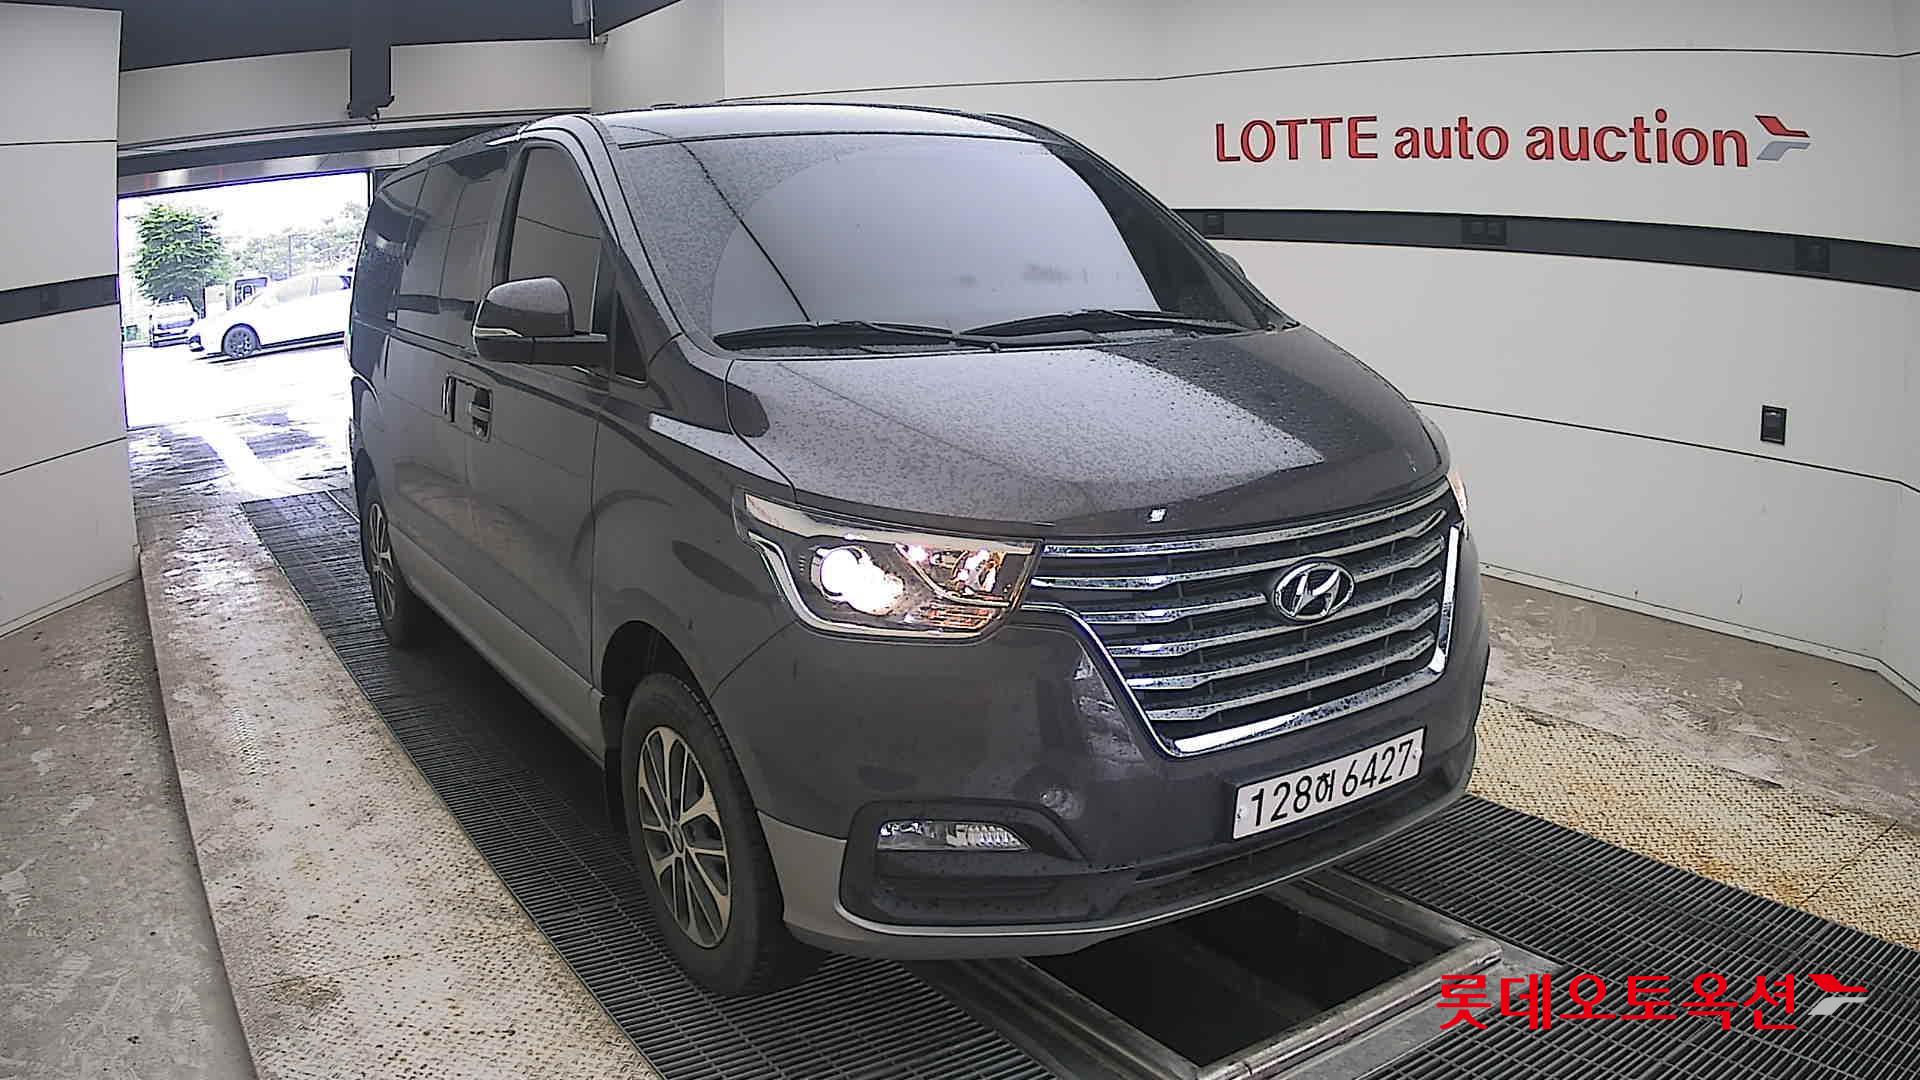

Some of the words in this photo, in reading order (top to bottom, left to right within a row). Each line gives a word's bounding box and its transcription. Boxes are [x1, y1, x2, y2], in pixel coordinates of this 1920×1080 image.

[1215, 115, 1378, 163] LOTTE
[1394, 116, 1511, 161] auto
[1525, 108, 1749, 168] auction
[1342, 738, 1414, 797] 6427
